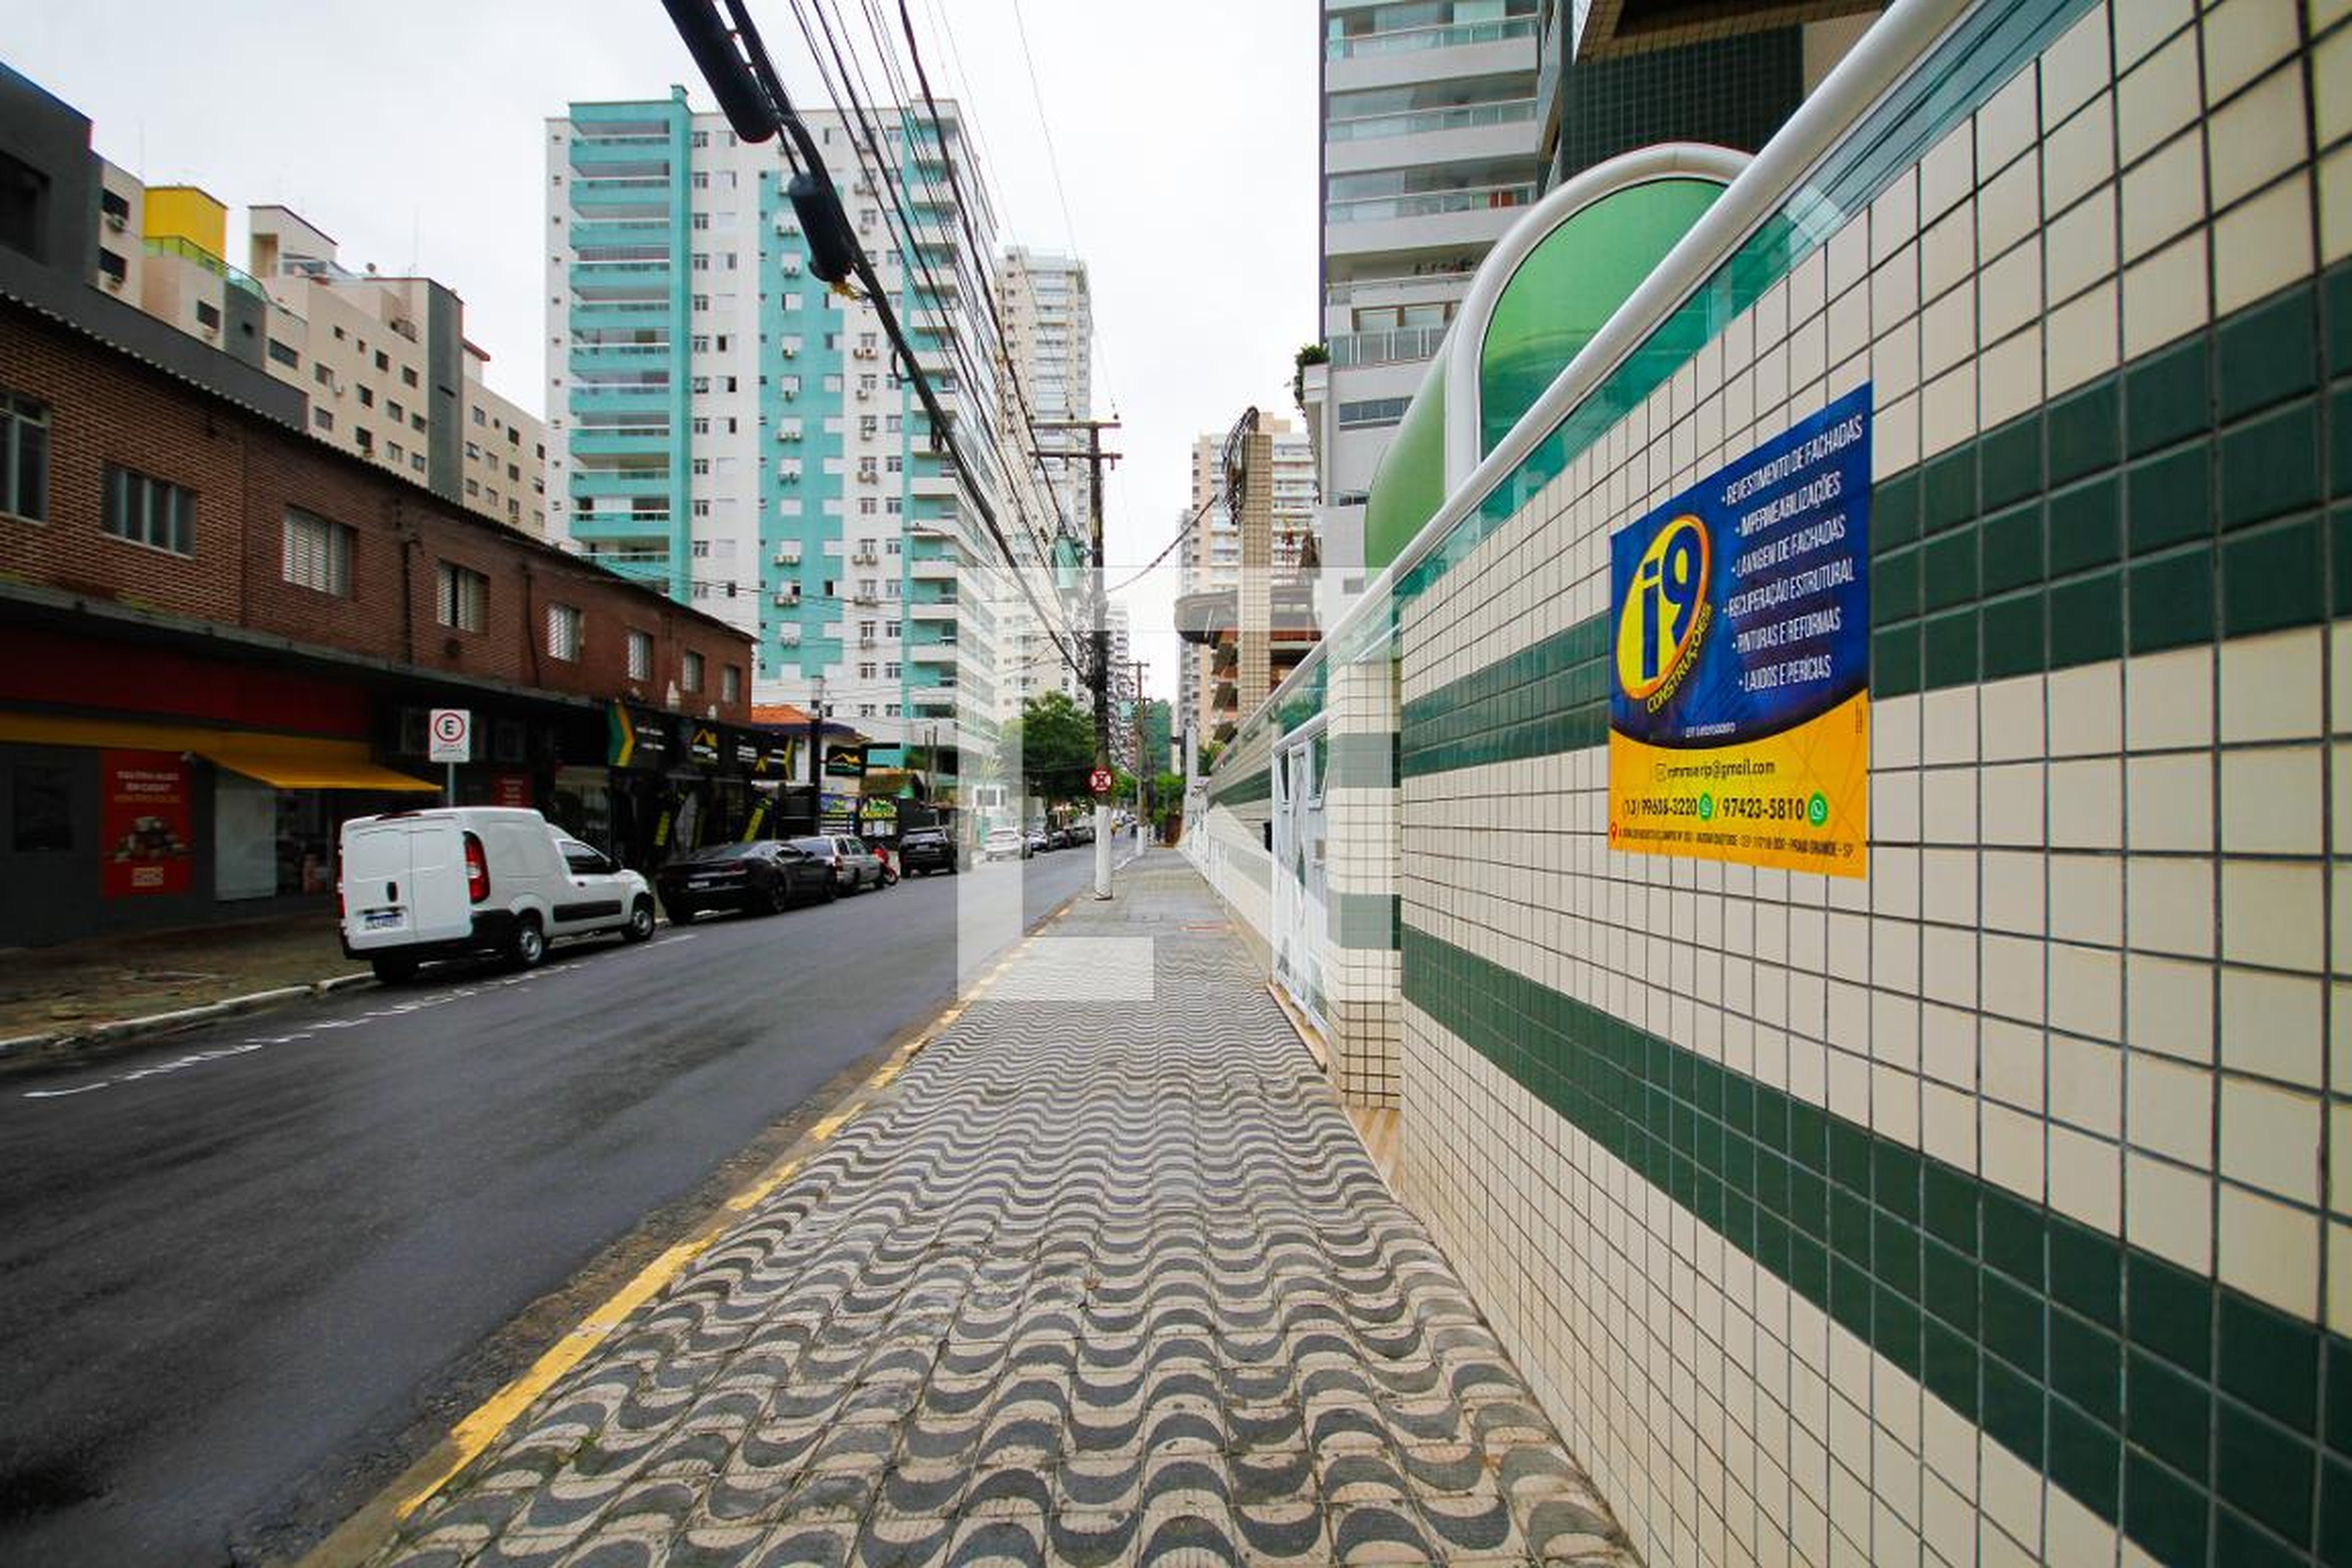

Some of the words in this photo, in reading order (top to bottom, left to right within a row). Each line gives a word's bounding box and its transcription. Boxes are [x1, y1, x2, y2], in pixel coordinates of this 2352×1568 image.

[1727, 455, 1791, 505] REVESTIMENTO
[1792, 447, 1803, 472] DE
[1804, 414, 1864, 462] FACHADAS
[1777, 537, 1790, 562] DE
[1790, 514, 1846, 556] FACHADAS
[1790, 557, 1855, 599] ESTRUTURAL
[1737, 624, 1778, 654] PINTURAS
[1780, 622, 1786, 644] E
[1787, 606, 1841, 642] REFORMAS
[1745, 665, 1778, 692] LAUDOS
[1780, 663, 1787, 685] E
[445, 720, 454, 735] E
[1722, 797, 1805, 820] 97423-5810
